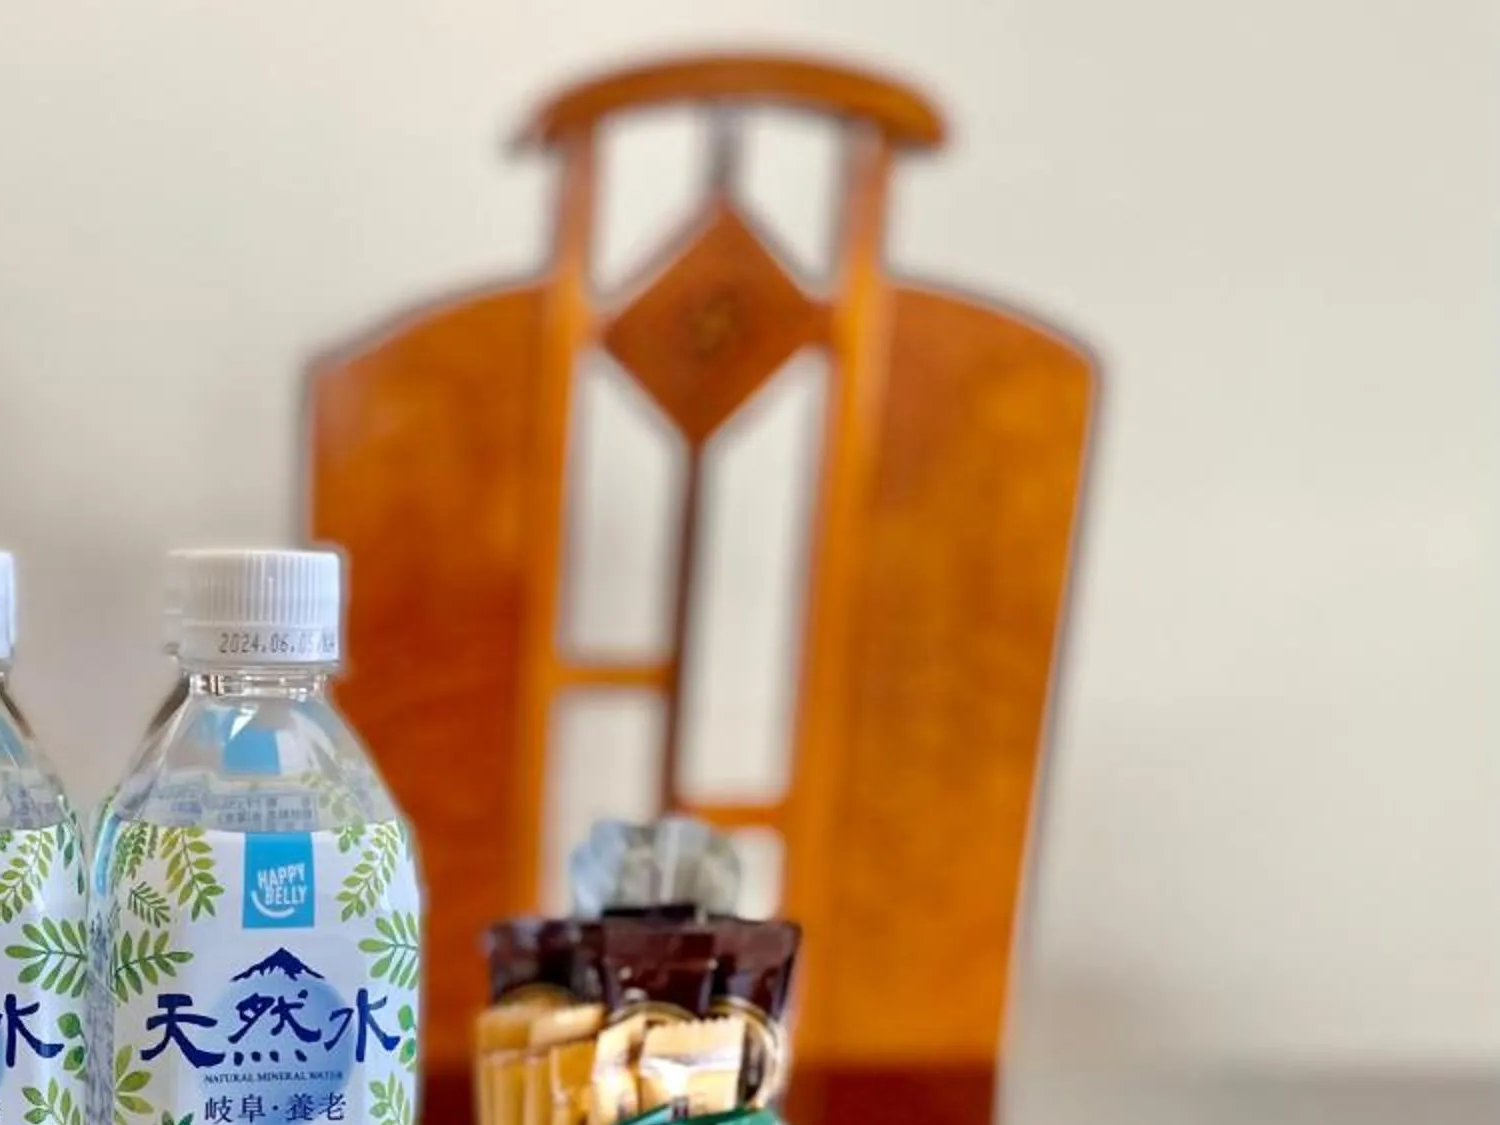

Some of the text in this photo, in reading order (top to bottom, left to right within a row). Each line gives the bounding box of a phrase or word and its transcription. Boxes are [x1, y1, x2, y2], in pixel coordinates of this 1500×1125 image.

[256, 862, 306, 888] HAPPY
[263, 883, 309, 907] BELLY
[139, 987, 402, 1070] 天然水
[203, 1070, 345, 1085] NATURAL MINERAL WATER
